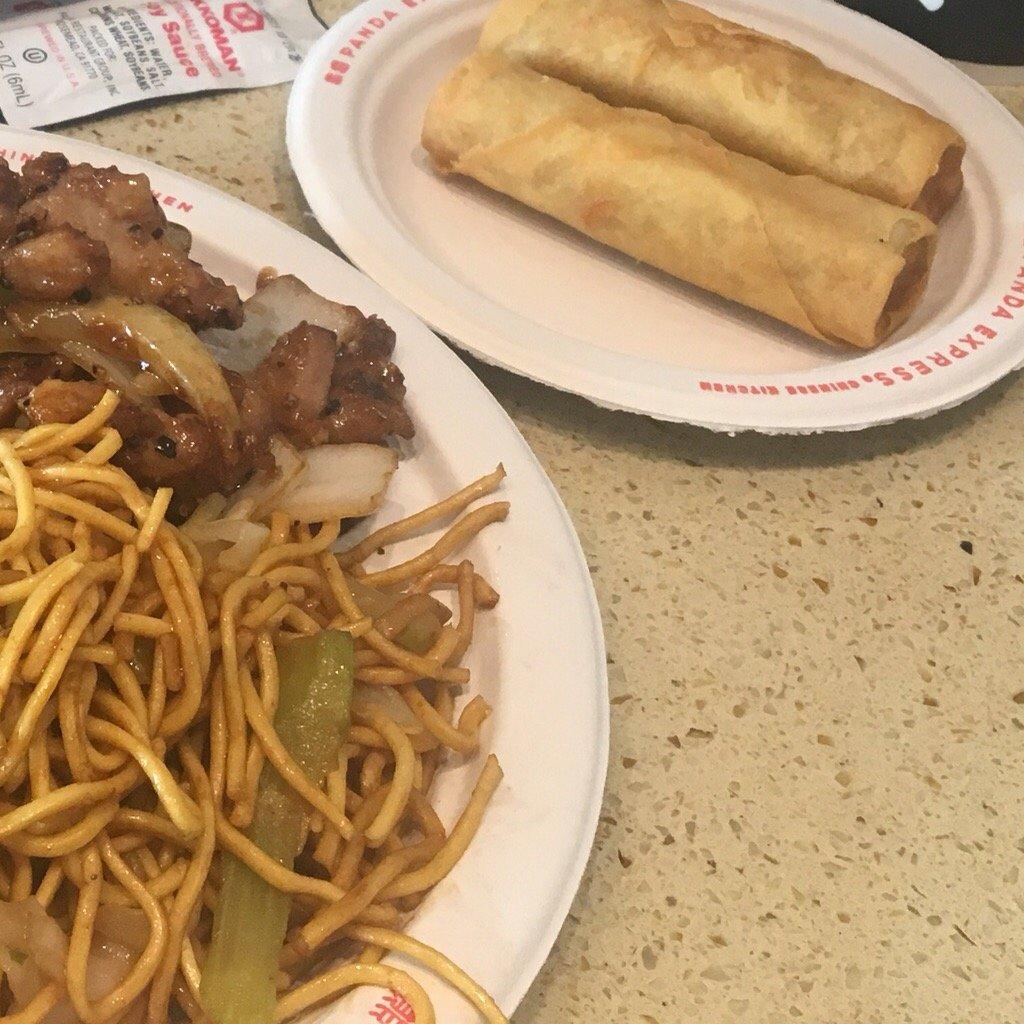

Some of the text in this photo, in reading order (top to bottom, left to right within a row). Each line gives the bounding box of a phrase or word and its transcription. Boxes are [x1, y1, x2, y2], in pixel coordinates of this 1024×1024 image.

[162, 21, 200, 78] Sauce
[339, 8, 399, 59] PANDA
[2, 72, 35, 108] (6mL)
[873, 324, 998, 387] EXPRESS
